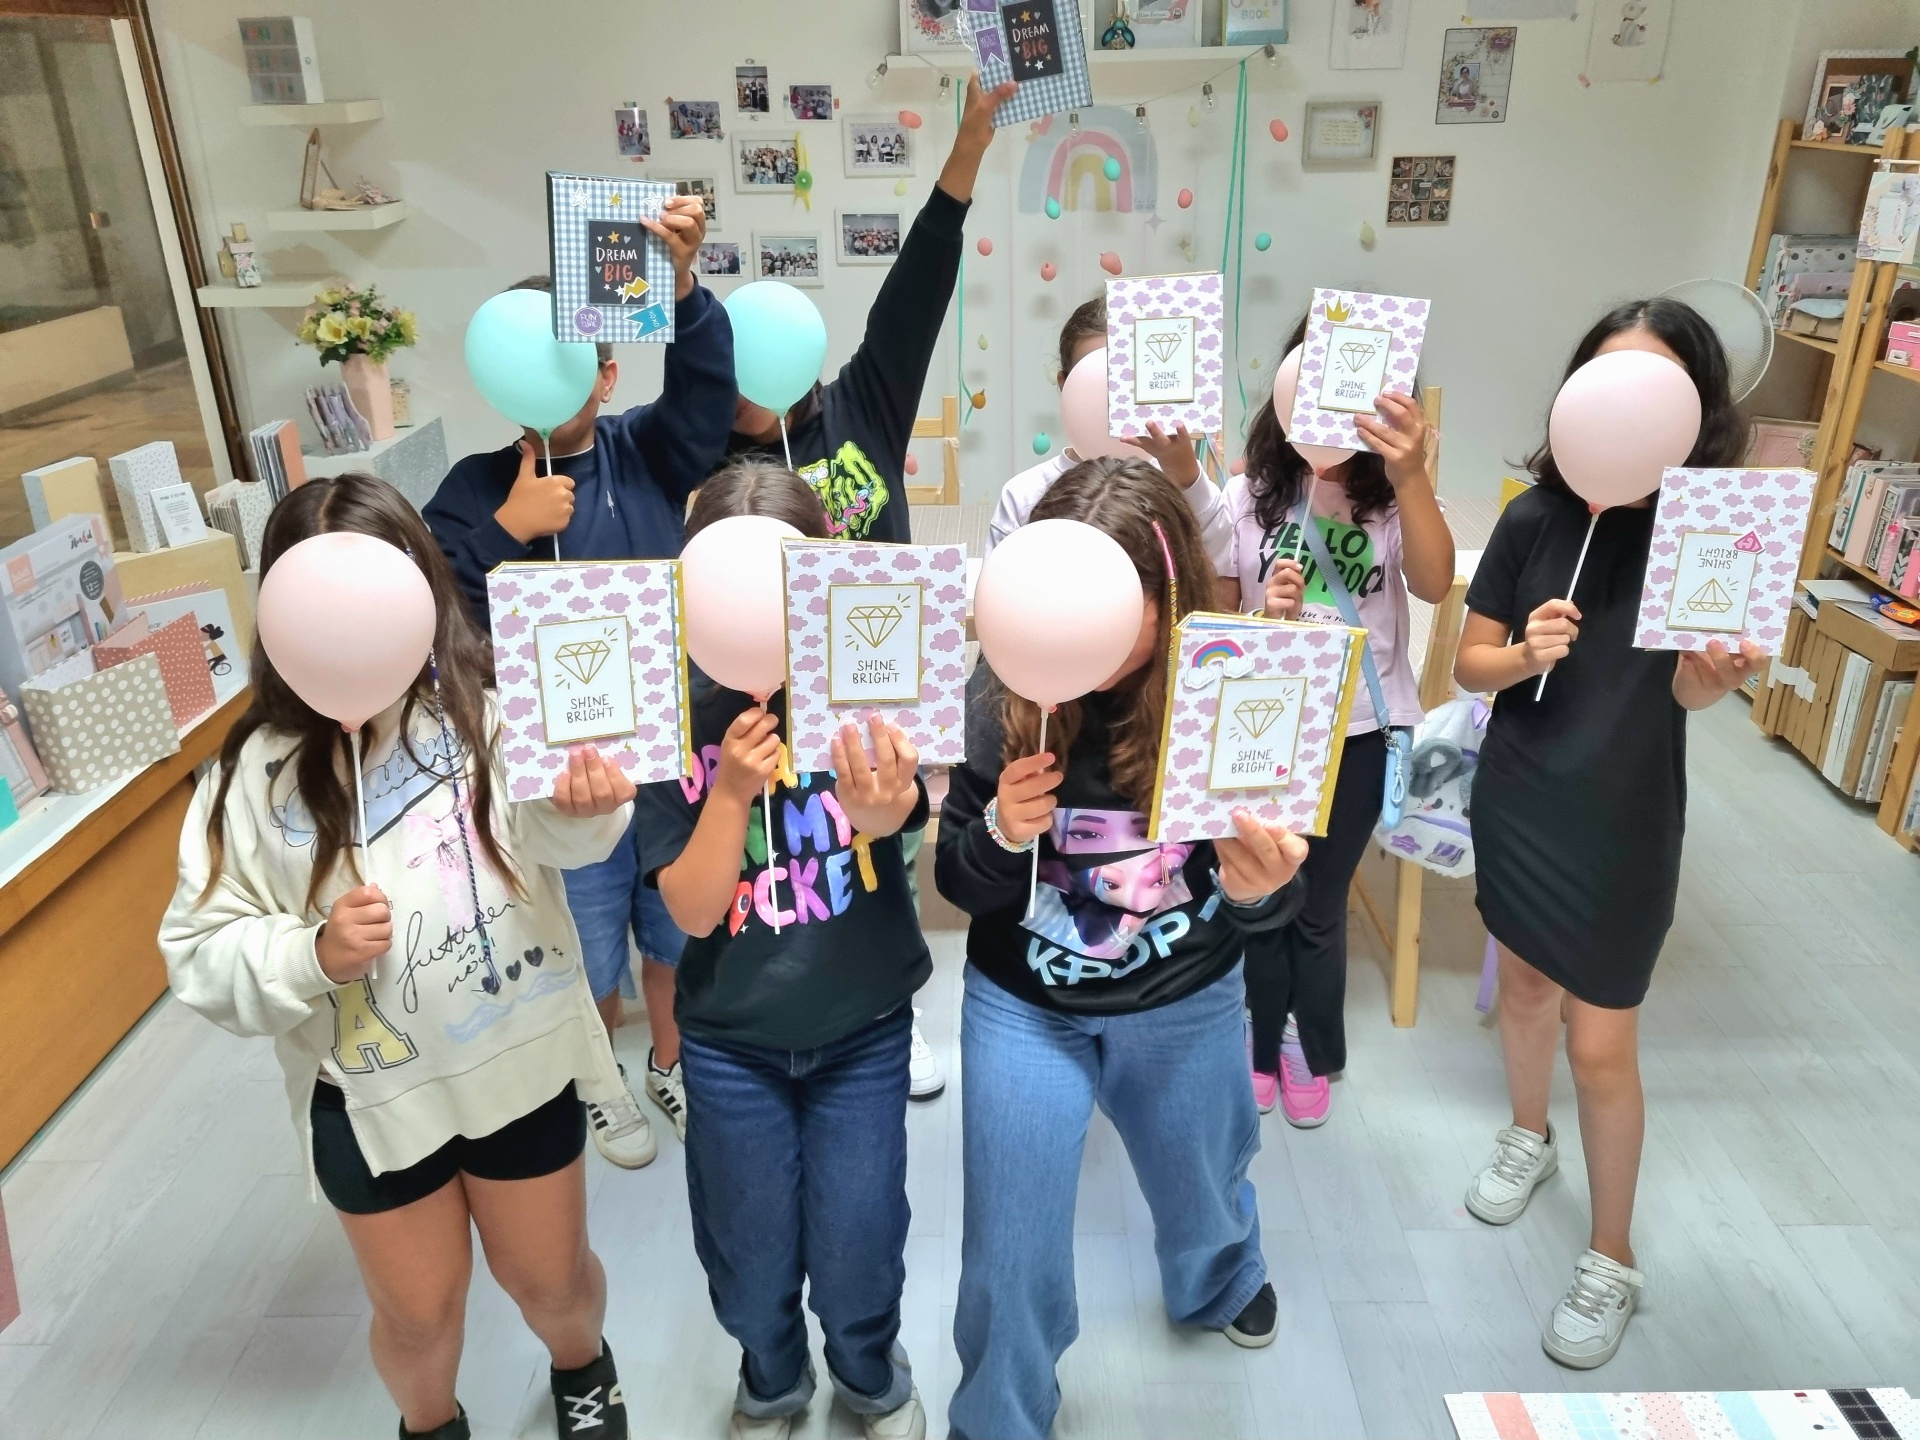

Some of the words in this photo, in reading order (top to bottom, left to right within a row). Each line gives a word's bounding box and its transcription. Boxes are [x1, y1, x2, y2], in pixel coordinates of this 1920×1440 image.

[1012, 22, 1050, 43] DREAM
[1021, 39, 1048, 60] BIG
[595, 246, 638, 263] DREAM
[604, 263, 633, 282] BIG
[579, 313, 597, 321] FUN
[1152, 370, 1178, 380] SHINE
[1149, 380, 1181, 390] BRIGHT
[1340, 379, 1366, 391] SHINE
[1335, 388, 1367, 400] BRIGHT
[1697, 547, 1738, 560] BRIGHT
[1698, 558, 1732, 570] SHINE
[857, 659, 896, 671] SHINE
[852, 672, 900, 684] BRIGHT
[570, 694, 609, 710] SHINE
[566, 706, 614, 723] BRIGHT
[1236, 748, 1273, 762] SHINE
[1231, 761, 1275, 774] BRIGHT
